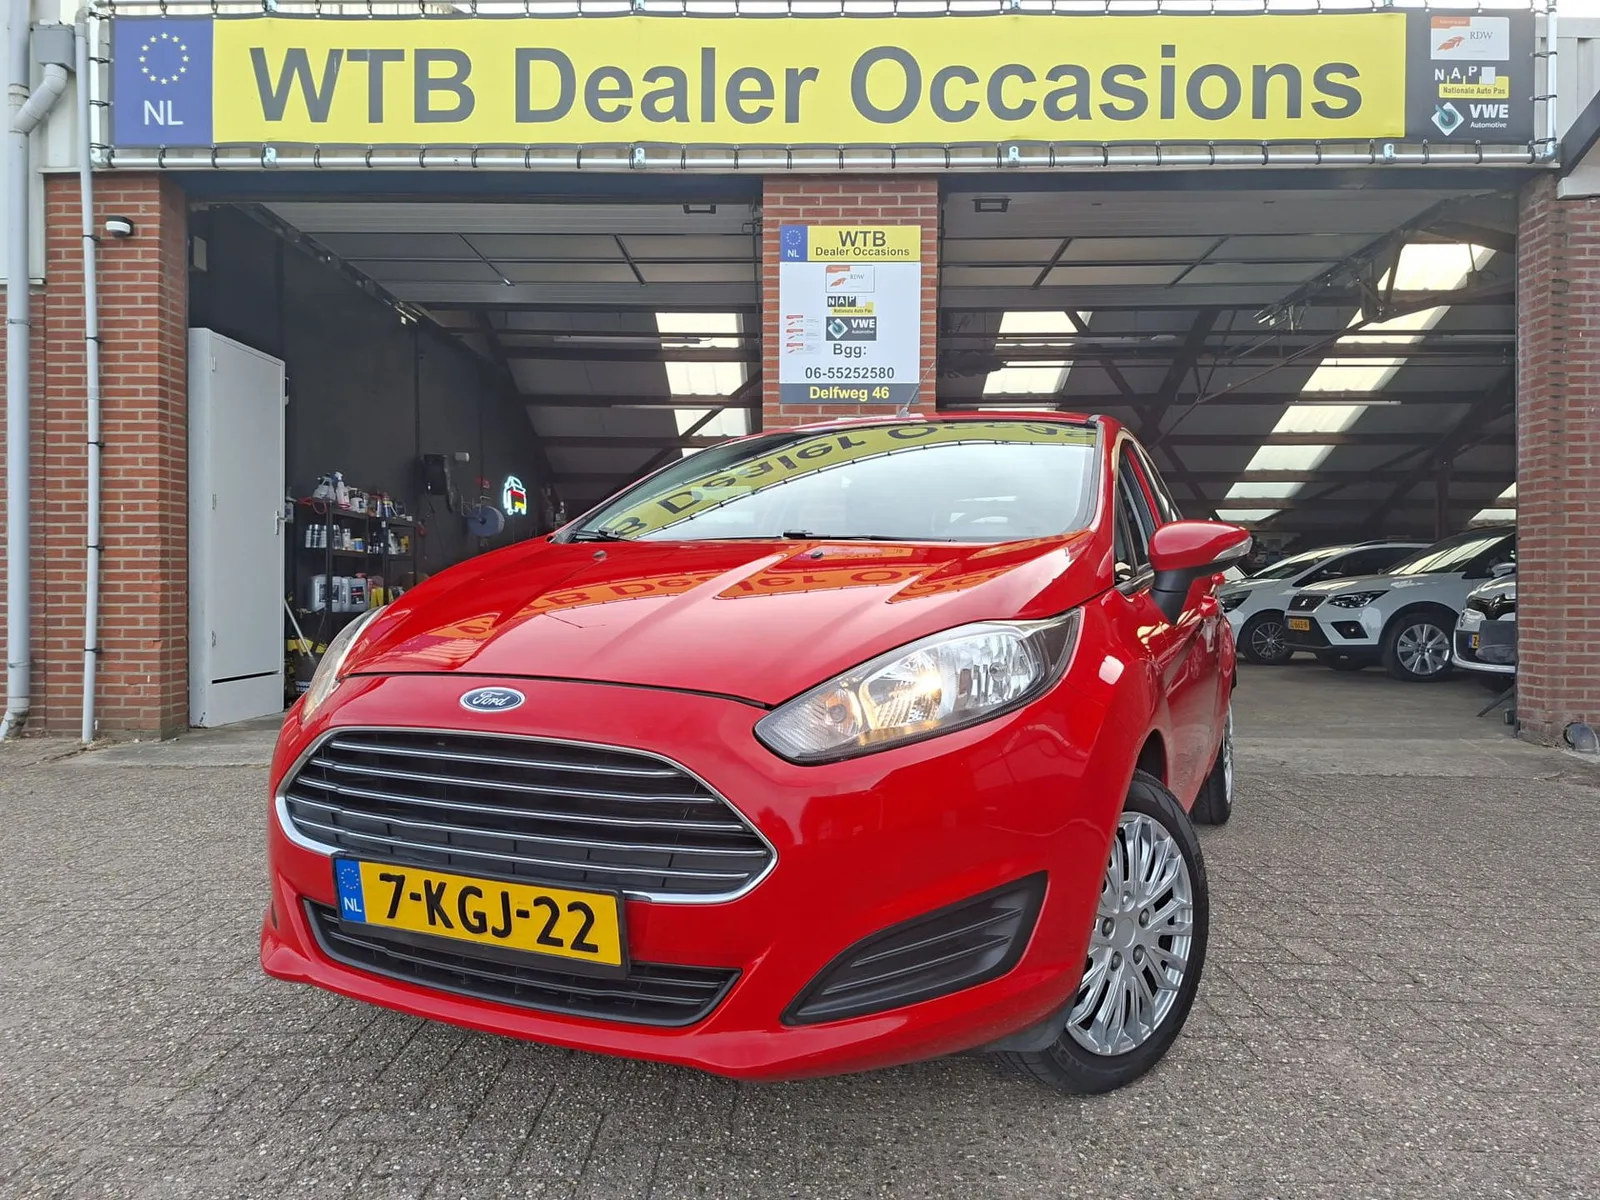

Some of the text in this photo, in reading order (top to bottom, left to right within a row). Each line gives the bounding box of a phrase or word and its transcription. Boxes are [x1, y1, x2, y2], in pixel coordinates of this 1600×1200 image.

[1470, 31, 1493, 40] RDW
[249, 44, 1363, 124] WTB Dealer Occasions
[1443, 86, 1506, 95] Nationale Auto Pas
[144, 100, 184, 125] NL
[1469, 104, 1509, 119] VWE
[1470, 121, 1507, 129] Automotive
[838, 230, 887, 247] WTB
[787, 249, 800, 258] NL
[815, 246, 910, 256] Dealer Occasions
[850, 318, 876, 329] VWE
[833, 343, 867, 358] Bgg:
[805, 366, 895, 379] 06-55252580
[809, 386, 890, 402] Delfweg 46
[472, 690, 511, 706] Ford
[343, 895, 362, 914] NL
[379, 872, 599, 953] 7-KGJ-22
